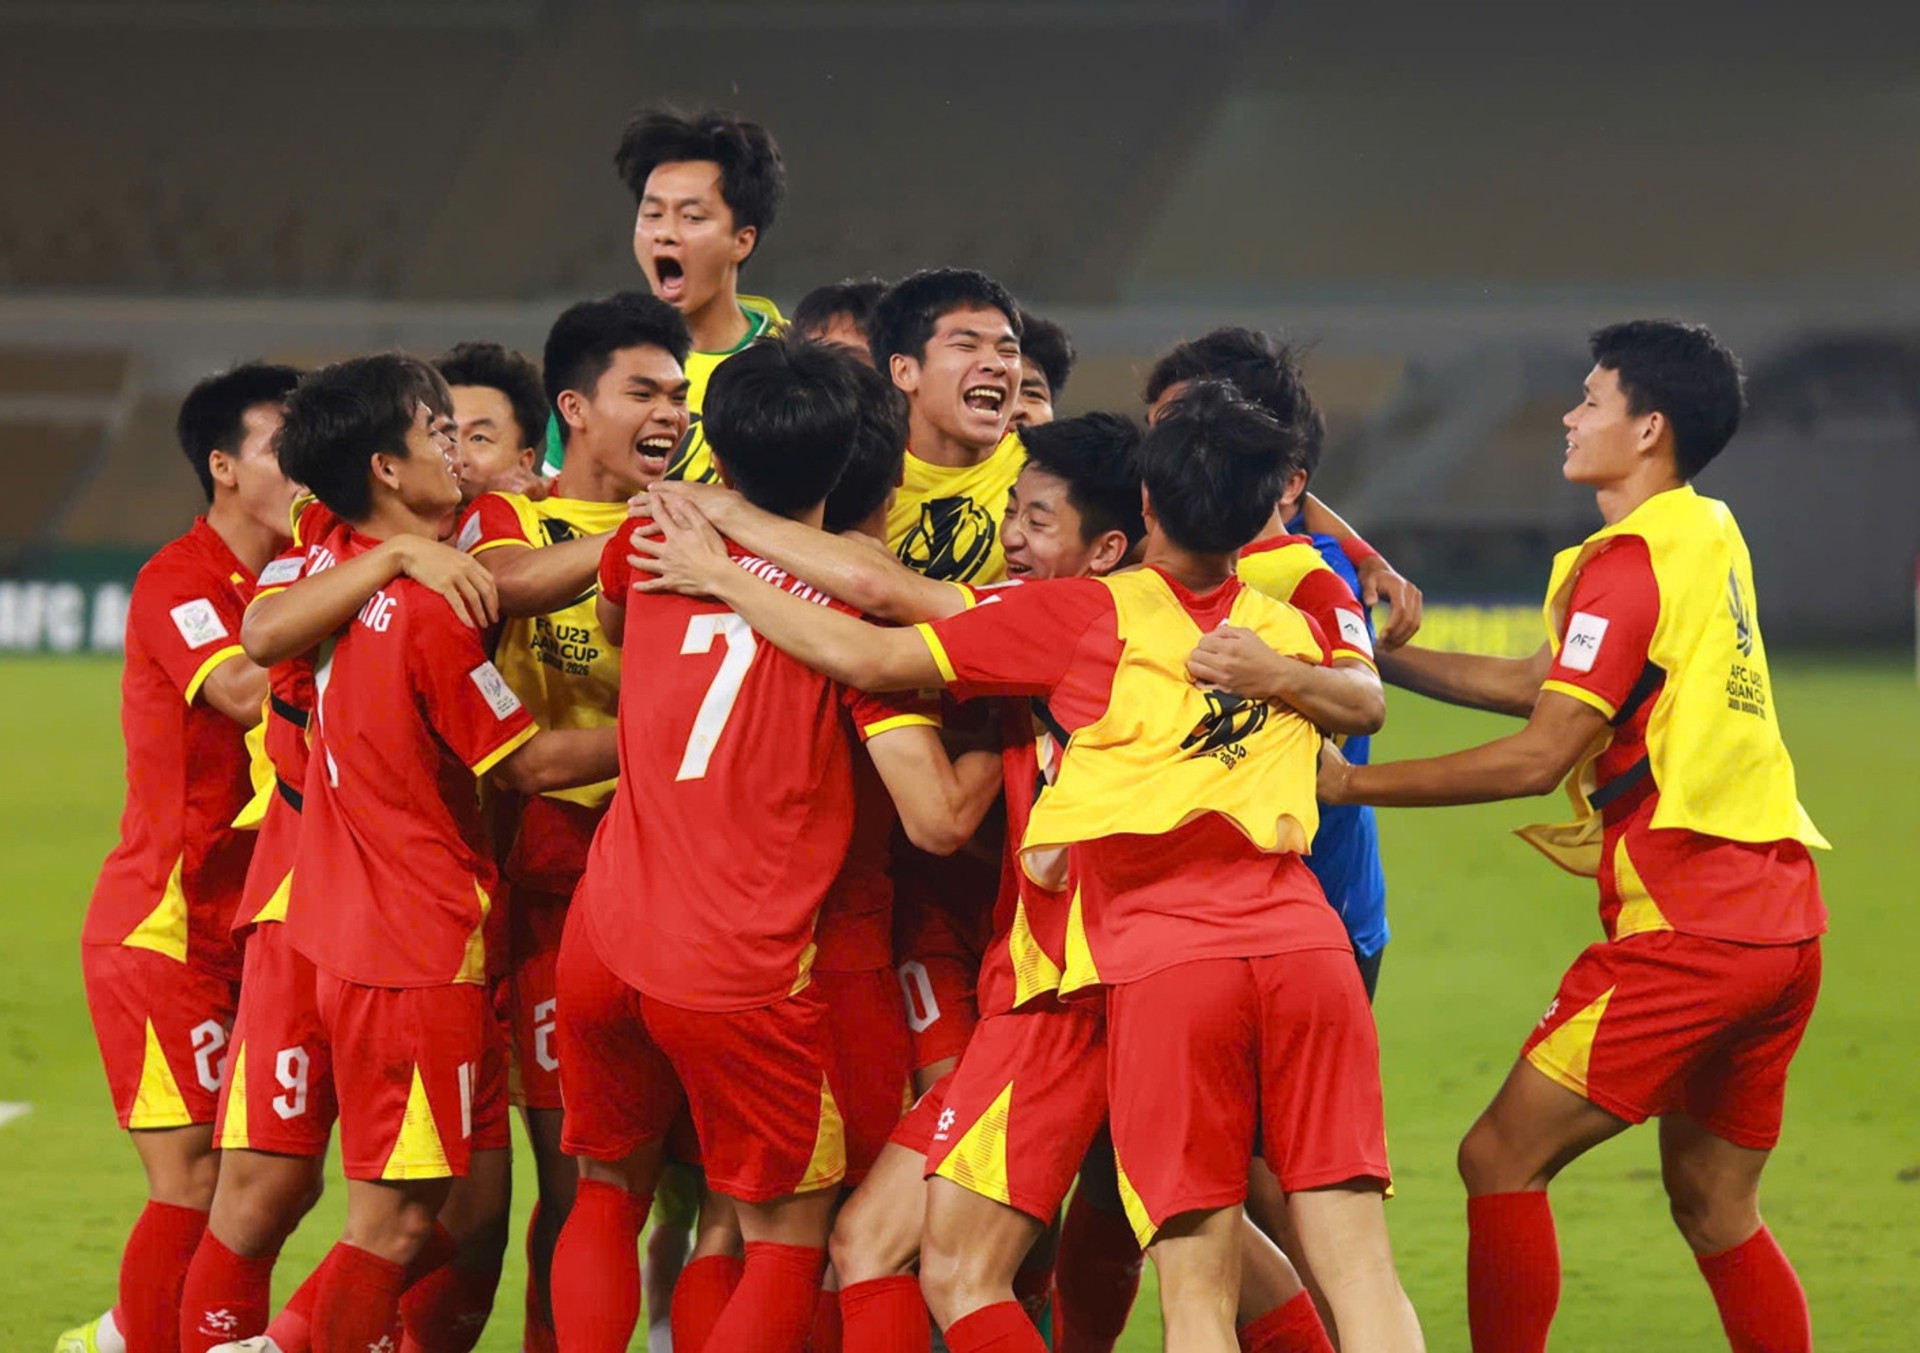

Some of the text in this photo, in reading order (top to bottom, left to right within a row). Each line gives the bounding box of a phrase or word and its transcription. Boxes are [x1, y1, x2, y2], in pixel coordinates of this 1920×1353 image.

[556, 625, 590, 645] U23
[1570, 633, 1596, 649] AFC
[560, 643, 599, 662] CUP
[1730, 664, 1748, 682] AFC
[675, 612, 758, 782] 7
[1726, 679, 1754, 700] ASIAN
[1226, 743, 1247, 759] UP
[272, 1045, 310, 1120] 9
